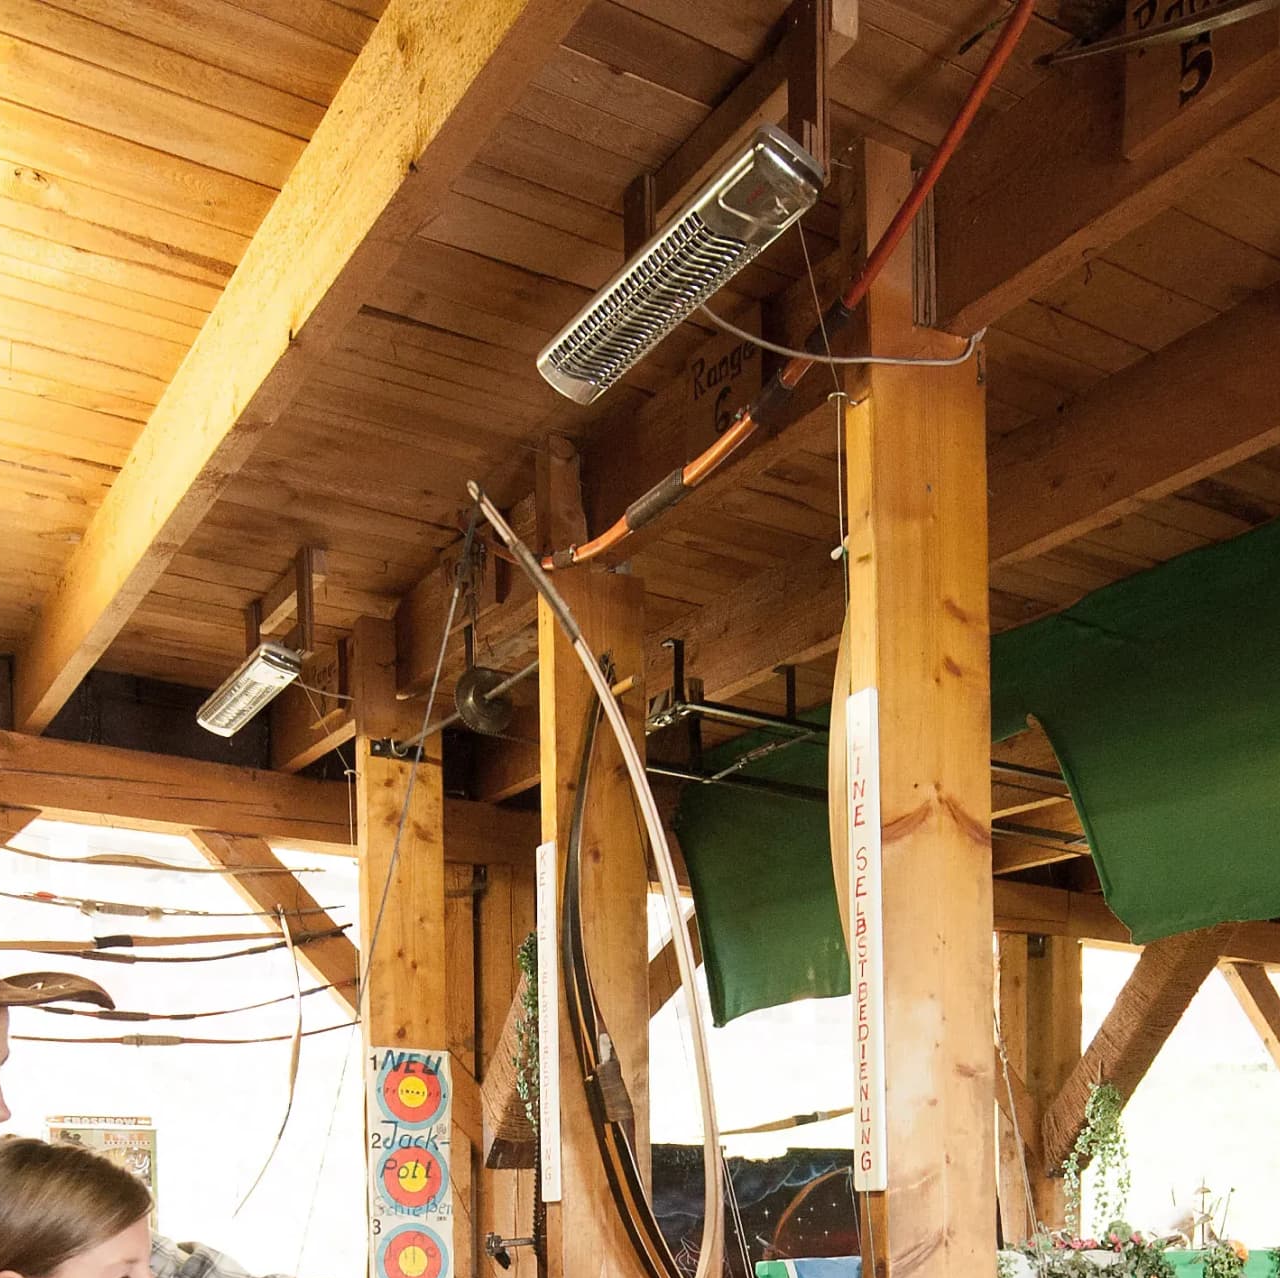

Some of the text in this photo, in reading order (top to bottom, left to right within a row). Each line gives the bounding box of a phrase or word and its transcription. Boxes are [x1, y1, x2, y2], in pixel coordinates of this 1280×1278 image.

[1178, 30, 1214, 109] 5
[853, 846, 873, 1174] SELBSTBEDIENUNG
[370, 1049, 443, 1076] 1 NEU
[371, 1133, 381, 1149] 2
[372, 1219, 382, 1236] 3
